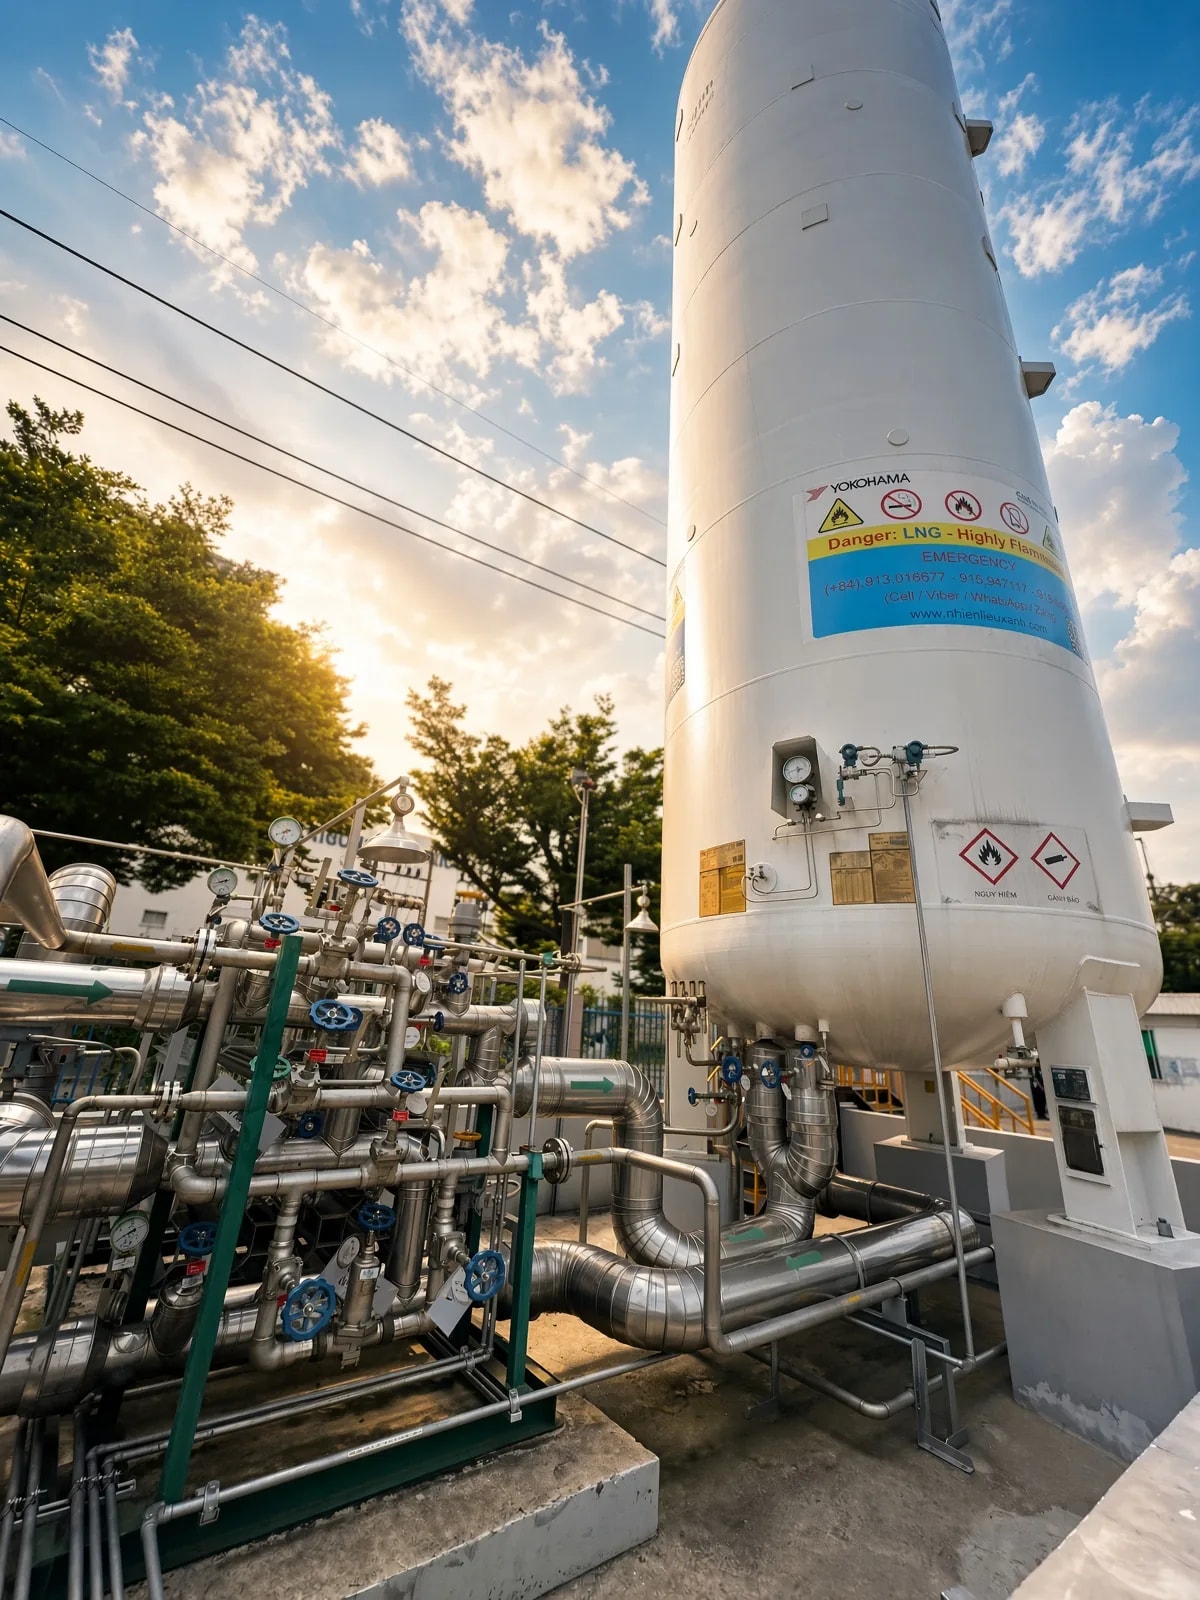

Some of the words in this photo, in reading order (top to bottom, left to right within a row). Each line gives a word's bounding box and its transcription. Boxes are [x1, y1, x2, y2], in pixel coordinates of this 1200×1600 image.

[830, 473, 911, 493] YOKOHAMA
[828, 531, 897, 550] Danger:
[903, 526, 942, 539] LNG
[957, 528, 1006, 549] Highly
[922, 551, 1016, 571] EMERGENCY
[884, 591, 915, 605] (Cell
[926, 590, 960, 601] Viber
[974, 890, 997, 898] NGUY
